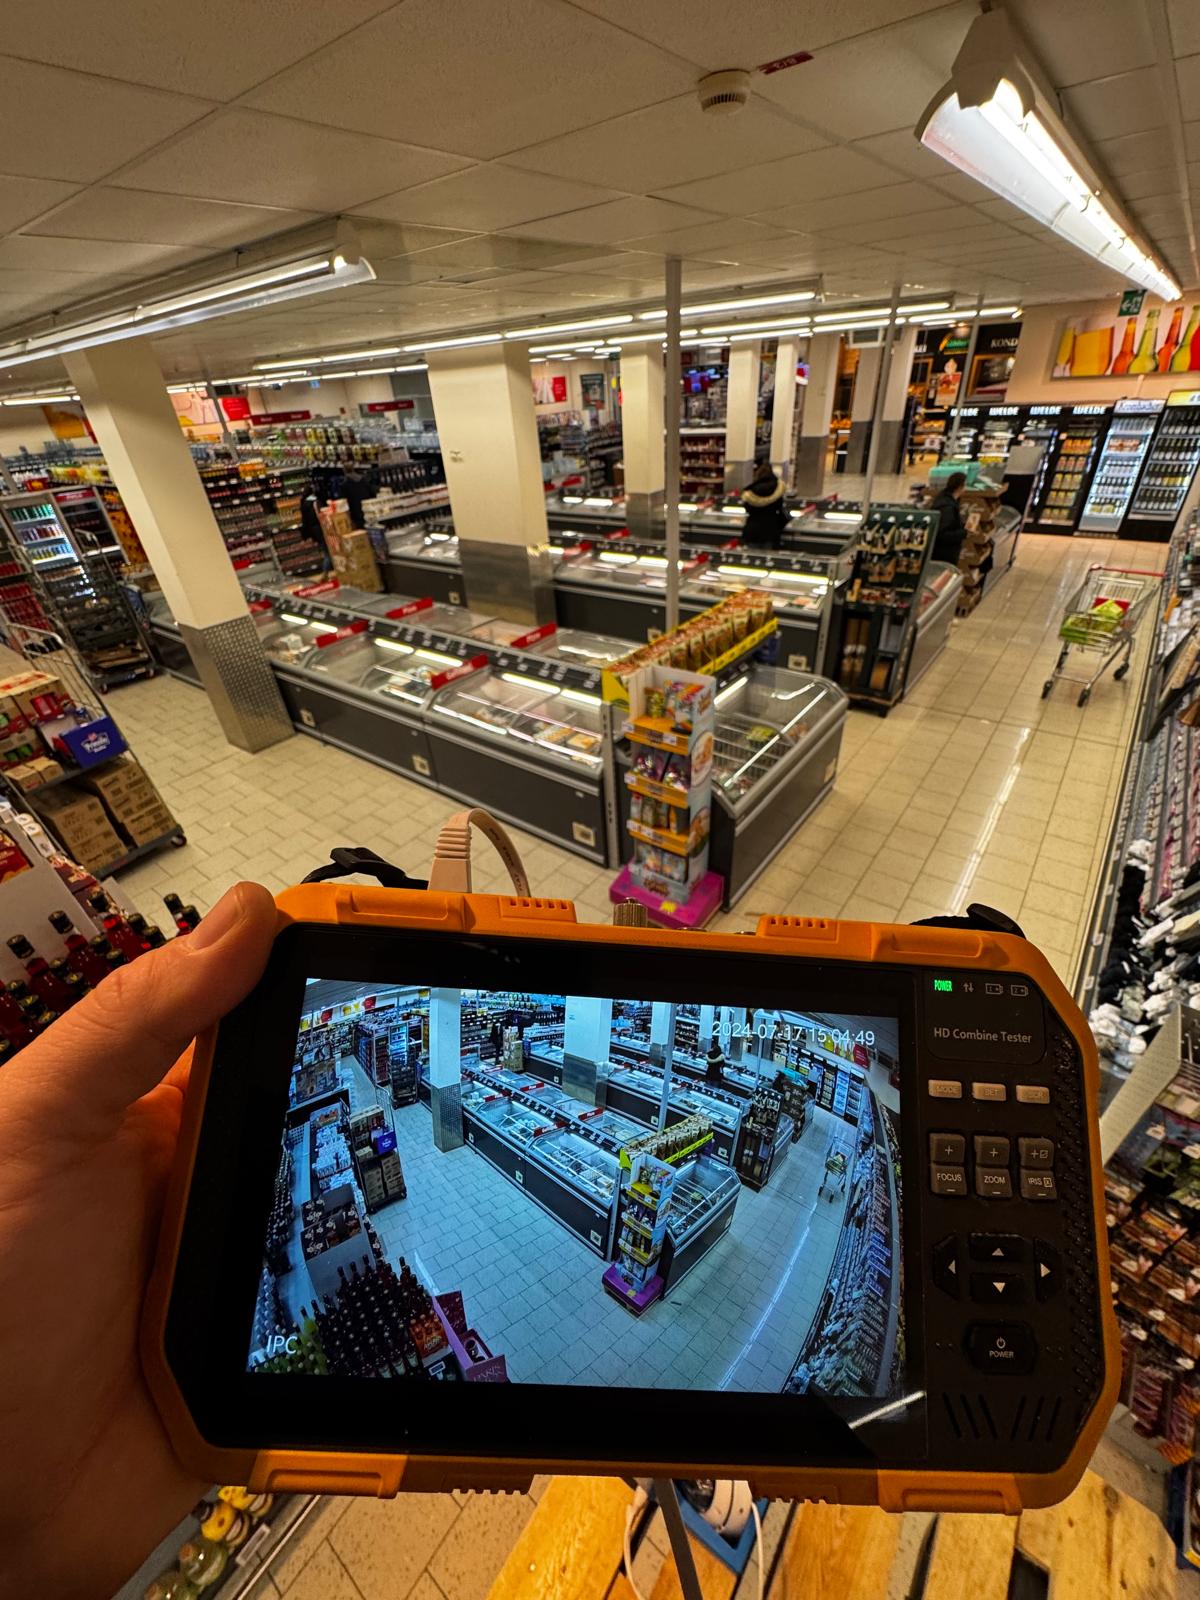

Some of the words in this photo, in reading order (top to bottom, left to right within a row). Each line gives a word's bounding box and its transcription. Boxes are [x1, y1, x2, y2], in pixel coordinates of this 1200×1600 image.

[988, 406, 1019, 416] WELDE
[1029, 406, 1062, 416] WELDE
[1073, 405, 1106, 415] WELDE
[934, 979, 952, 992] POWER
[712, 1021, 803, 1041] 2024-07-17
[934, 1027, 950, 1039] HD
[953, 1028, 998, 1041] Combine
[1000, 1031, 1032, 1043] Tester
[937, 1173, 962, 1182] FOCUS
[984, 1175, 1005, 1184] ZOOM
[1028, 1177, 1043, 1186] IRIS
[266, 1335, 298, 1354] IPC
[989, 1350, 1014, 1359] POWER
